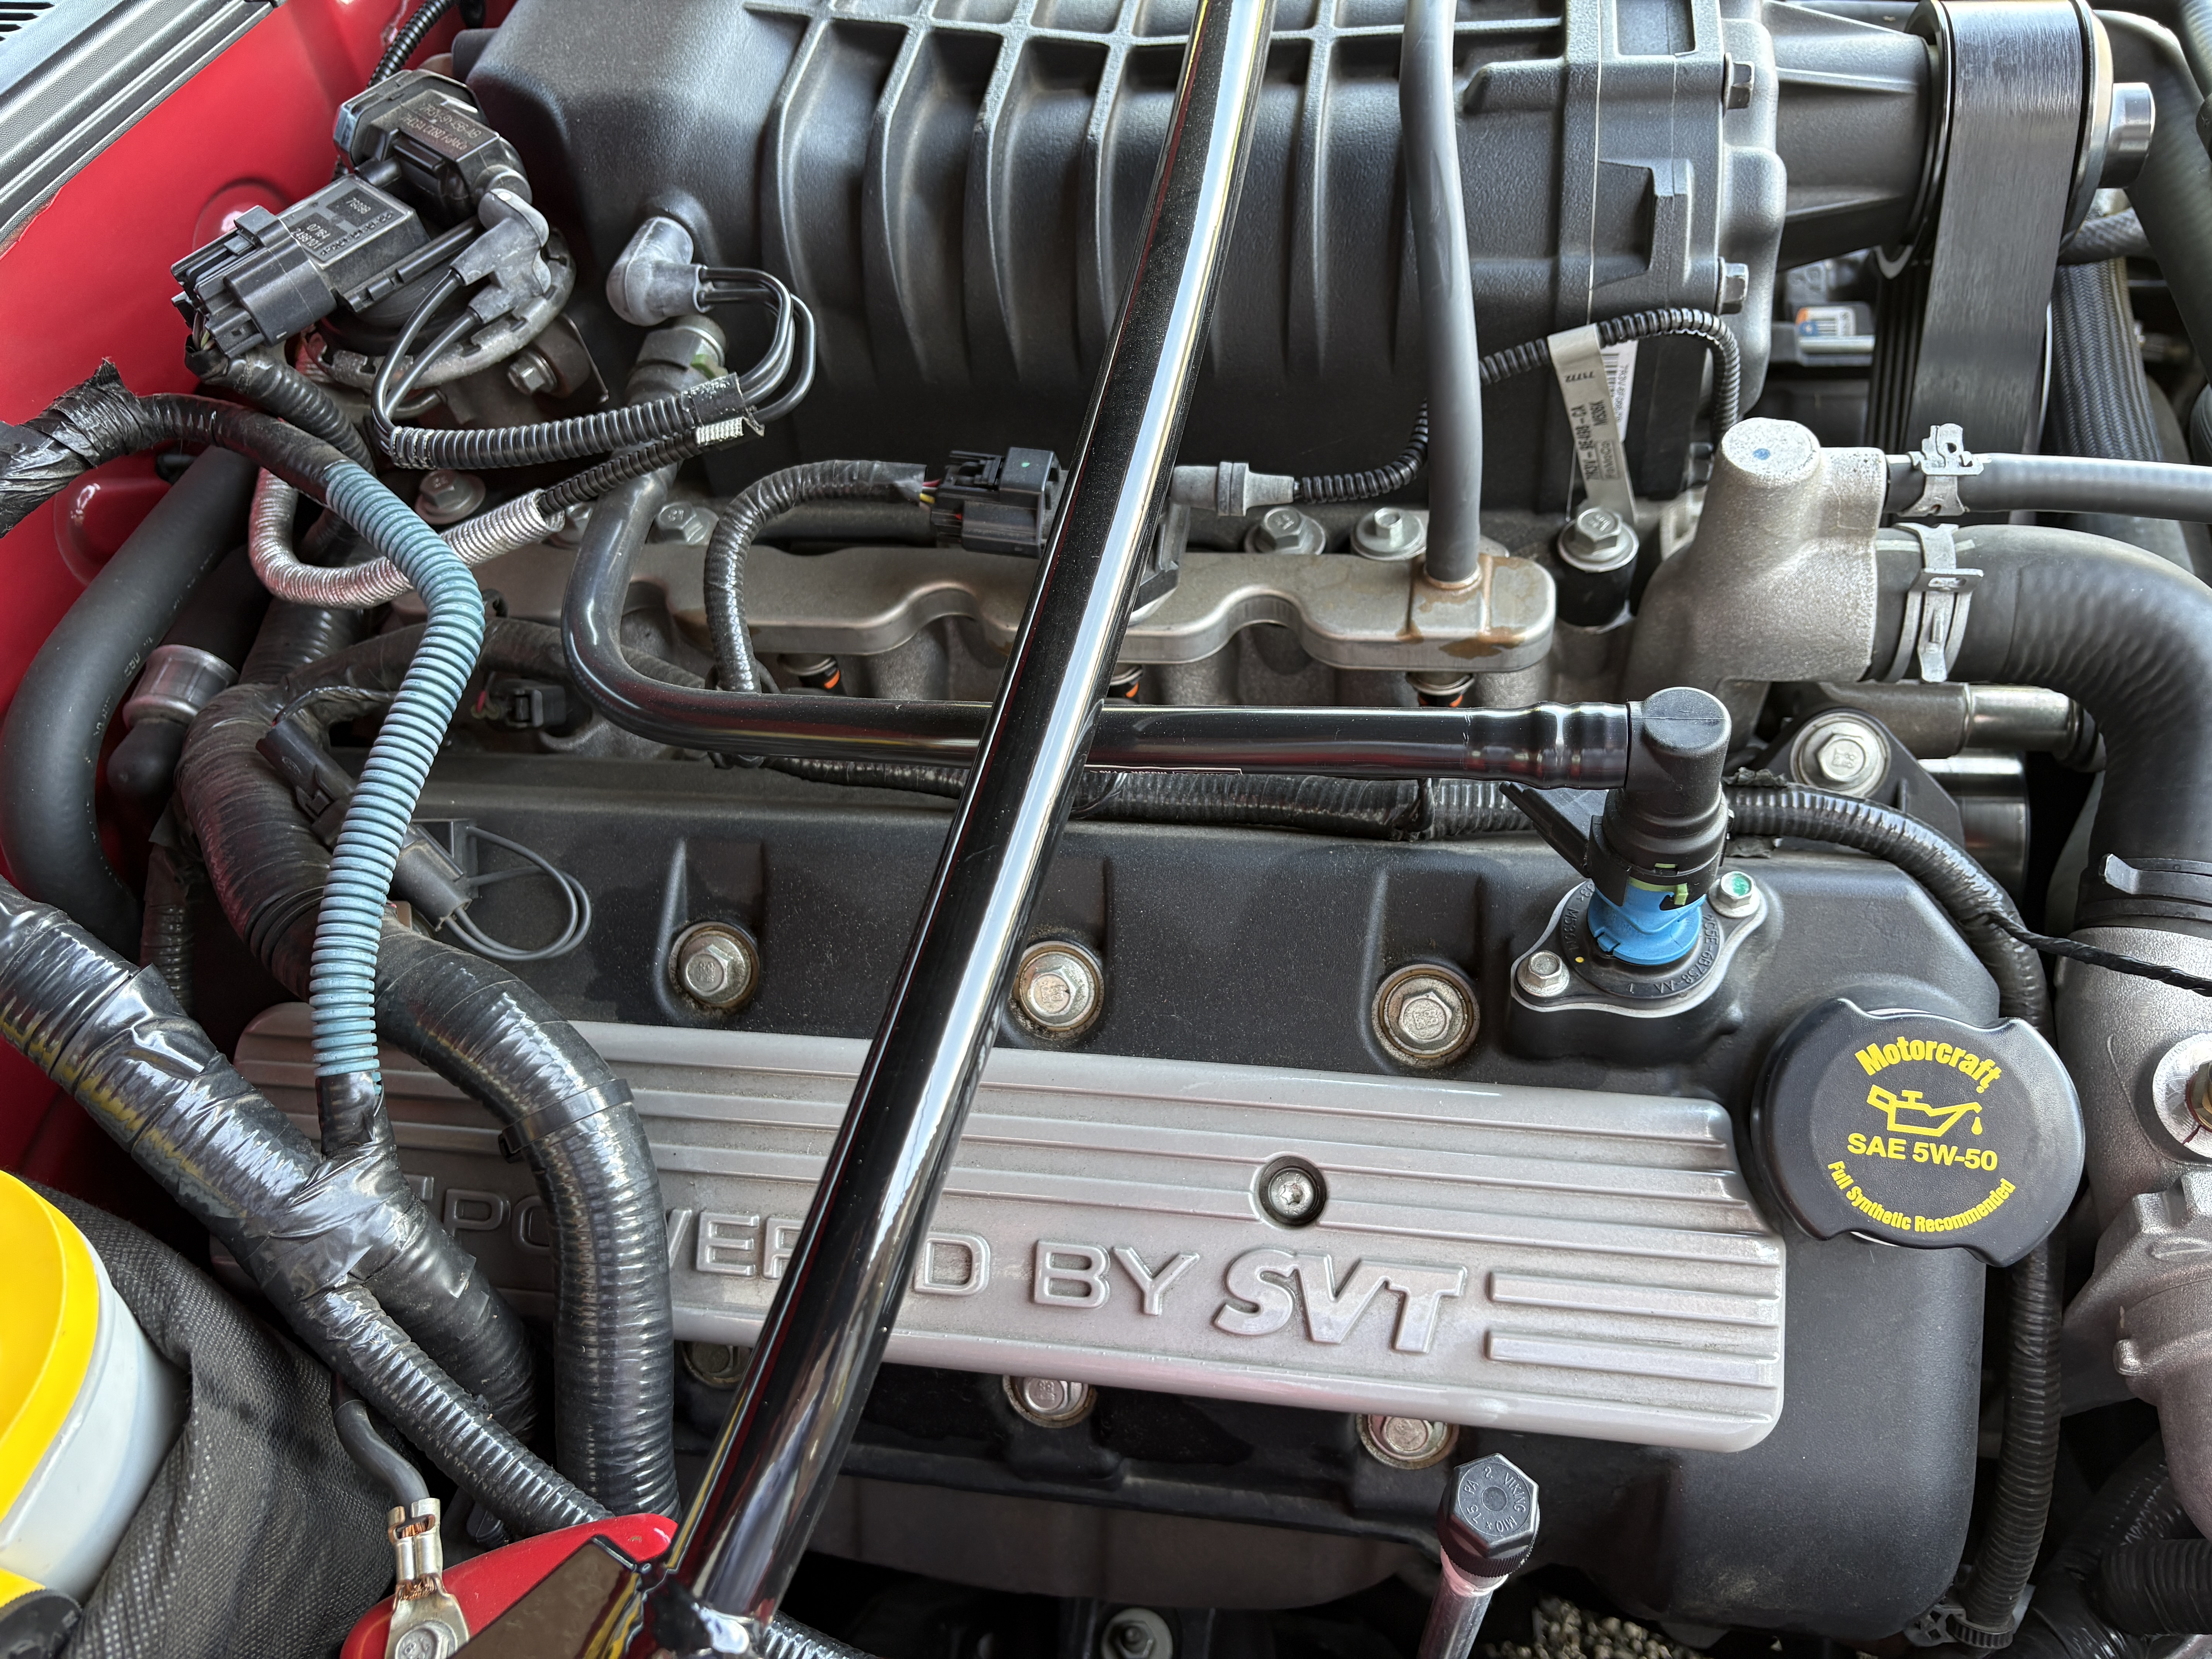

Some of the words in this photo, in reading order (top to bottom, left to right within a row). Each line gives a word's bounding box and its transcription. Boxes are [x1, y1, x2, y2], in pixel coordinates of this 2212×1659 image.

[1854, 1036, 2002, 1089] Motorcraft
[1847, 1133, 1907, 1160] SAE
[1913, 1143, 1998, 1171] 5W-50
[1828, 1160, 1854, 1189] Full
[1846, 1186, 1911, 1231] Synthetic
[1915, 1178, 2016, 1232] Recommended
[1032, 1239, 1202, 1317] BY
[1213, 1247, 1468, 1354] SVT
[1503, 1472, 1526, 1513] VIKING
